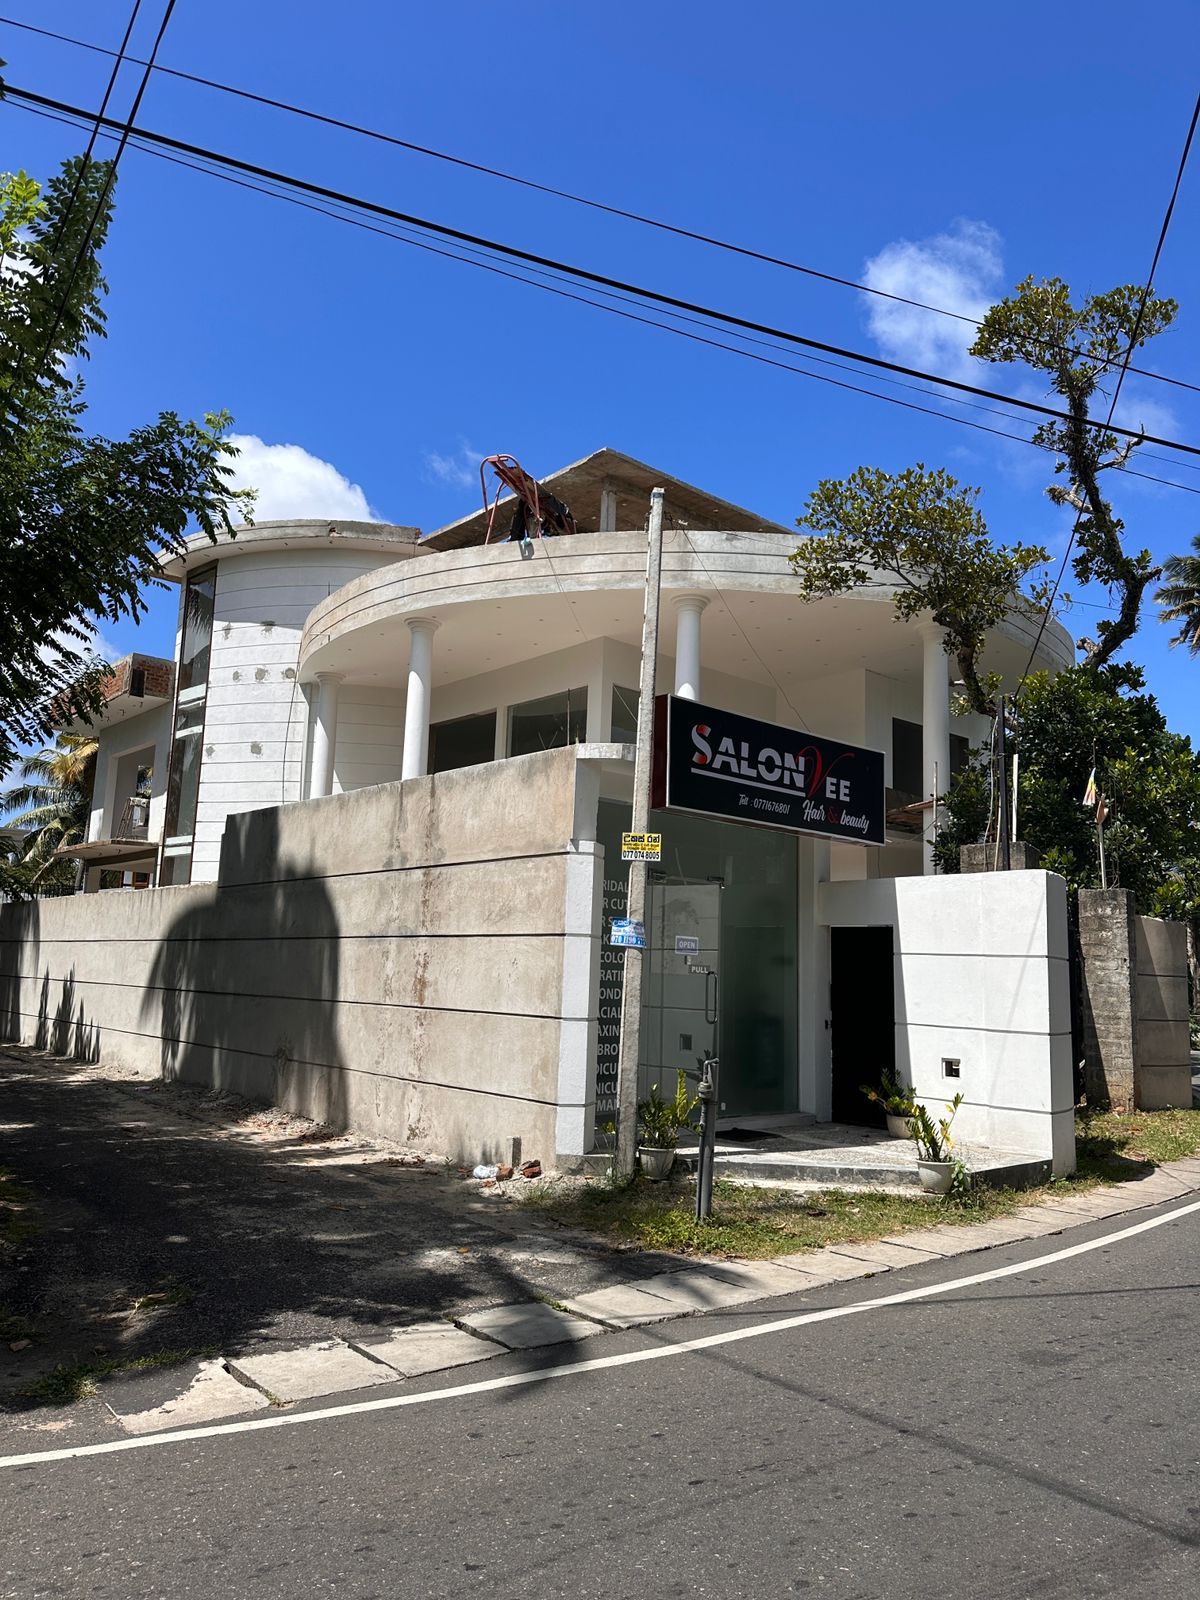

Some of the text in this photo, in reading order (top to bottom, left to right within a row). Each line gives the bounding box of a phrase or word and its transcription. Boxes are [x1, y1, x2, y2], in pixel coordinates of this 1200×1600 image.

[691, 724, 805, 788] SALON
[802, 799, 827, 822] Hair
[840, 809, 870, 834] beauty
[622, 850, 634, 859] 077
[602, 879, 628, 893] RIDAL
[679, 940, 696, 949] OPEN
[691, 965, 709, 974] PULL
[597, 1043, 620, 1056] BRO
